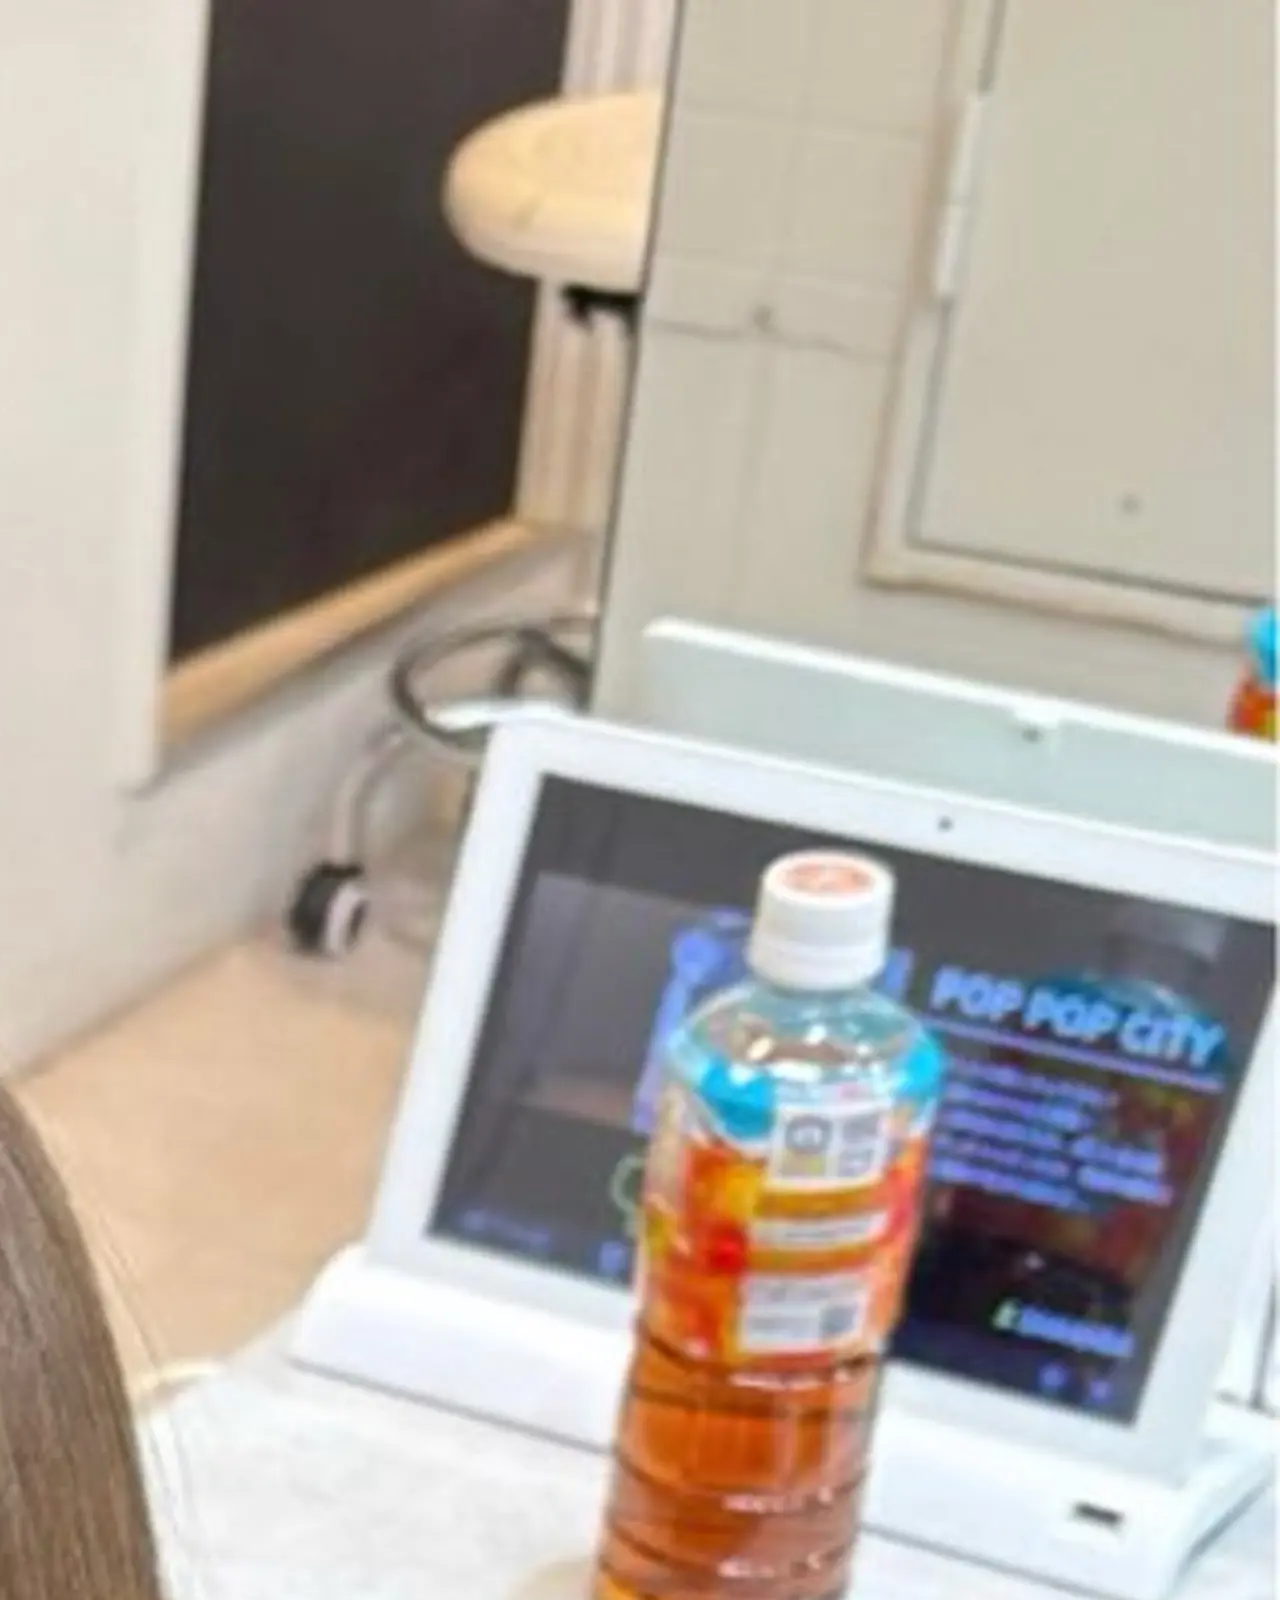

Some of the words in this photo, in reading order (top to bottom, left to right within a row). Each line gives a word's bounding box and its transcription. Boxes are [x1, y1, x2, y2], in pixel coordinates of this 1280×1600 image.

[931, 966, 1023, 1021] POP
[1021, 990, 1119, 1041] POP
[1119, 1009, 1227, 1067] CITY
